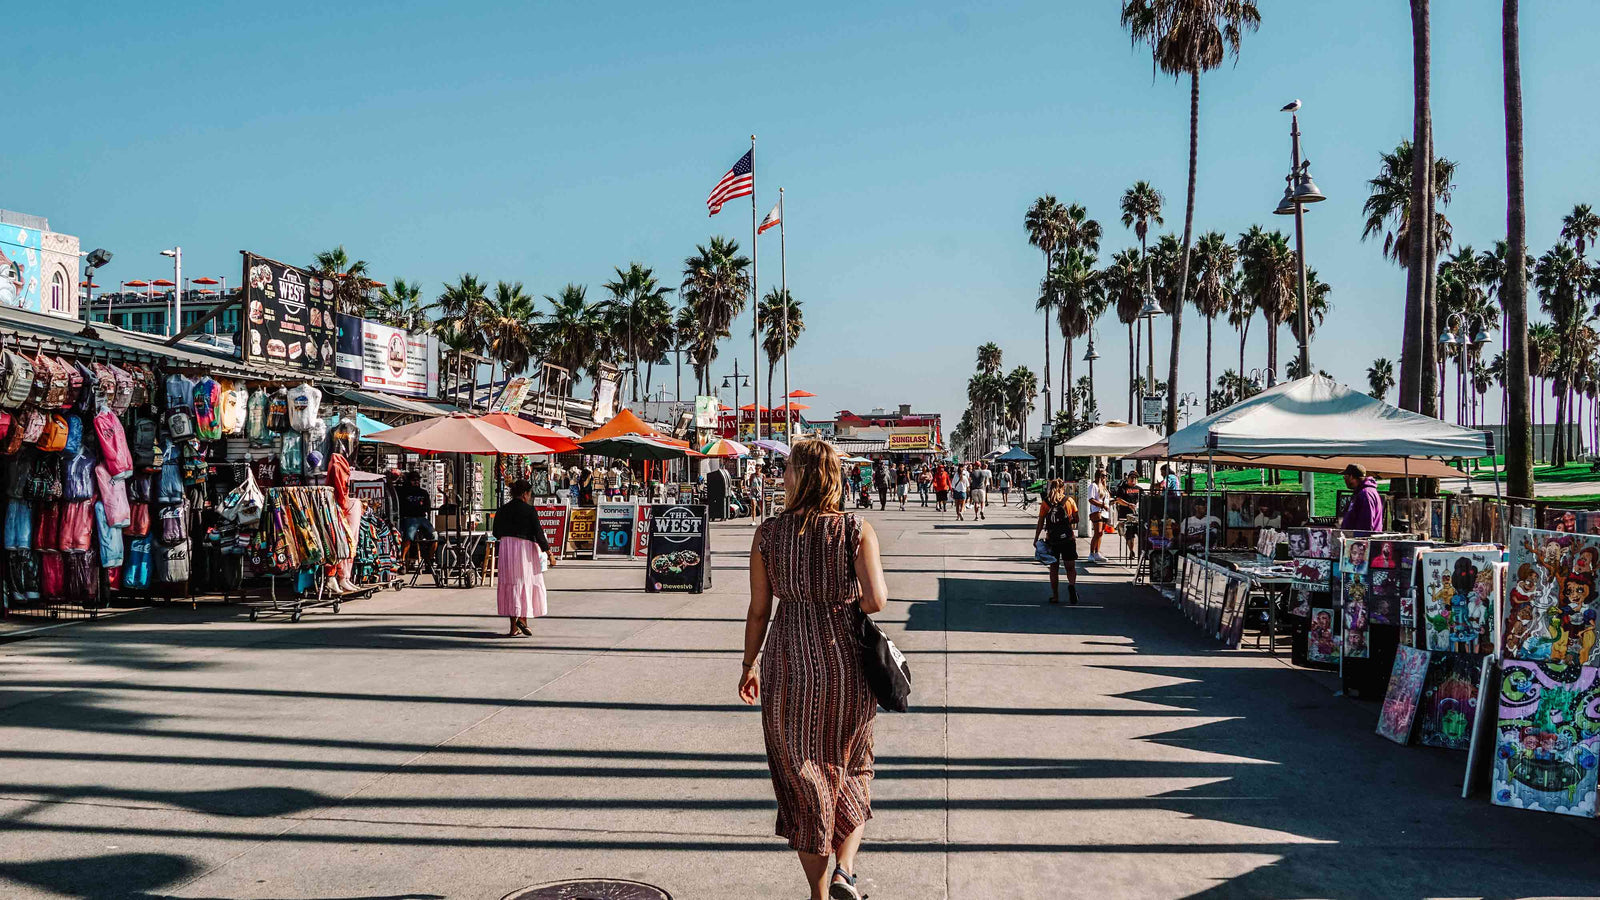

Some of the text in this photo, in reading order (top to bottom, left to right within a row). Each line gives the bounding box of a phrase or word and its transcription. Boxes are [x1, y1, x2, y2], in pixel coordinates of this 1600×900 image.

[287, 273, 298, 283] THE
[279, 280, 306, 304] WEST
[891, 435, 927, 444] SUNGLASS
[357, 488, 381, 499] ATM
[573, 521, 593, 532] EBT
[655, 519, 702, 533] WEST
[600, 530, 628, 547] $10
